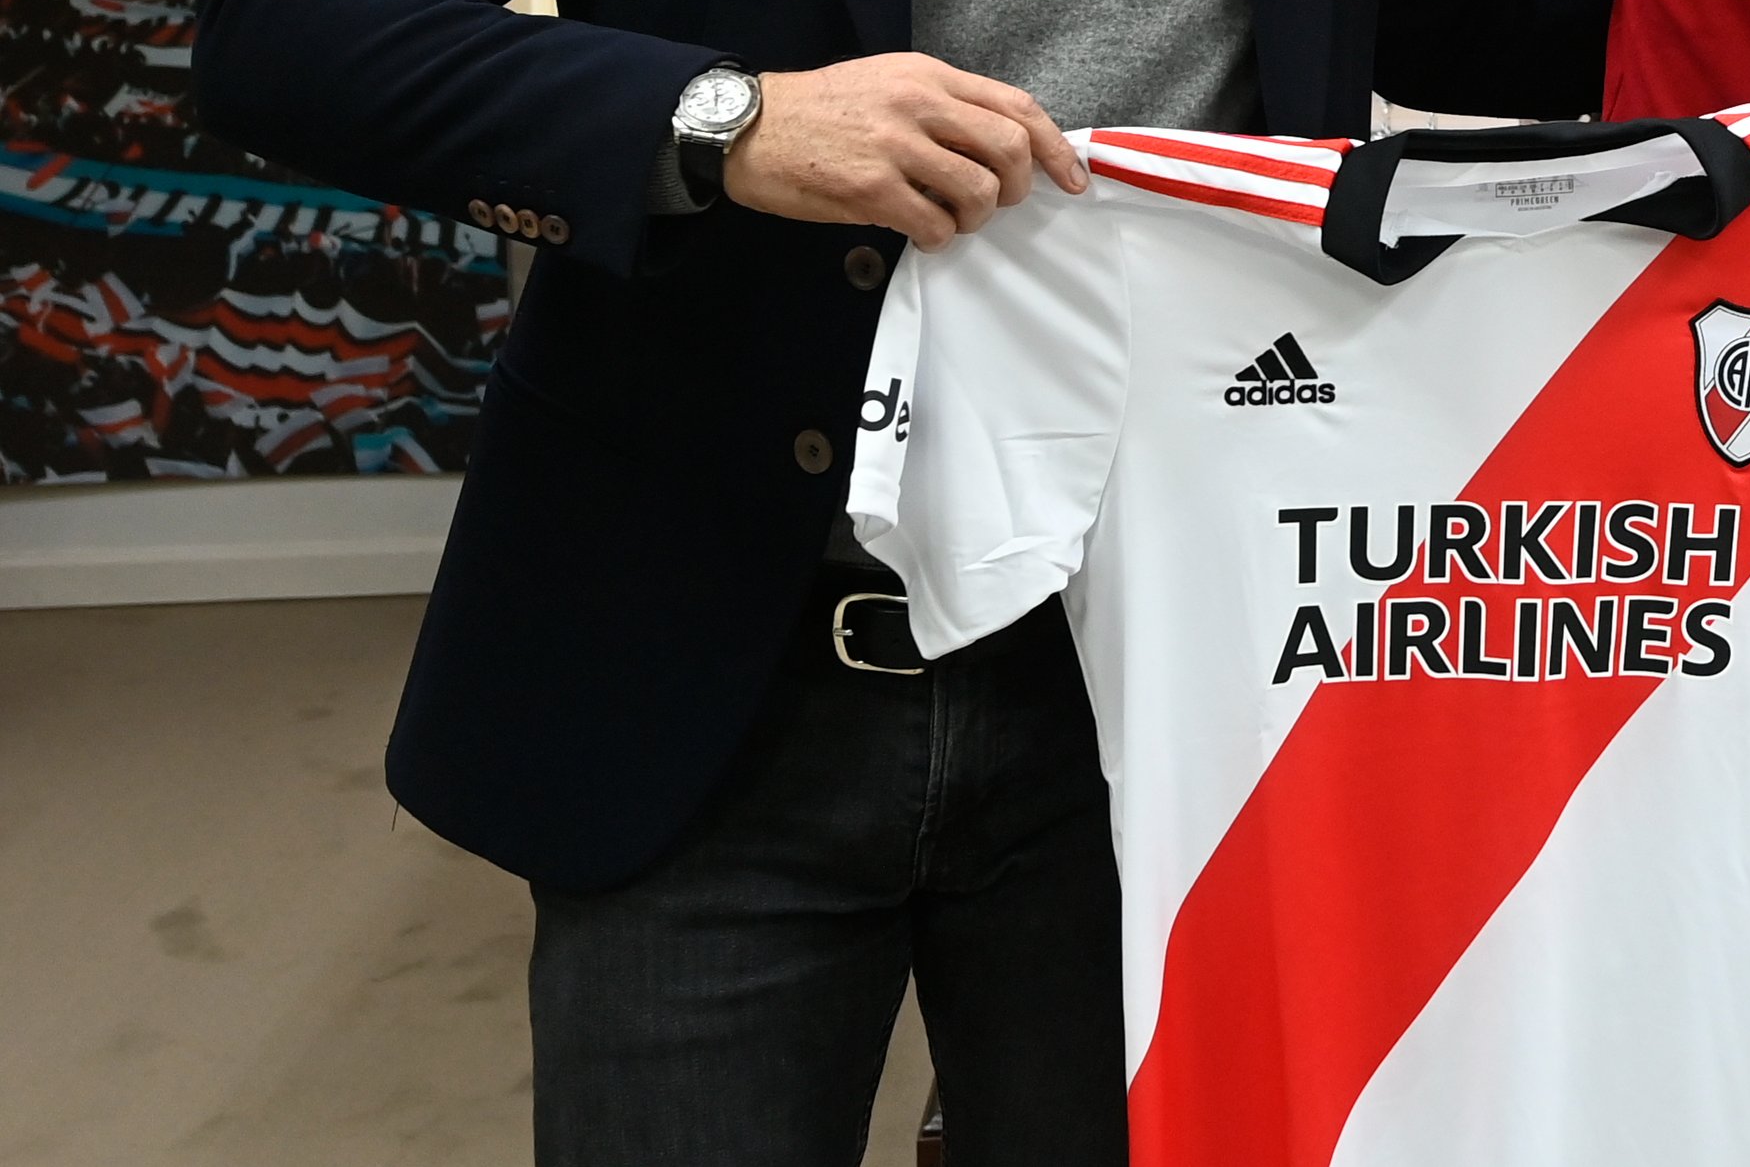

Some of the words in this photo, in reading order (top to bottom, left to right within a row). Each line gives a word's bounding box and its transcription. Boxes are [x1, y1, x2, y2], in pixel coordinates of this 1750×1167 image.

[1224, 379, 1336, 407] adidas
[1277, 502, 1740, 584] TURKISH
[1270, 598, 1733, 685] AIRLINES
